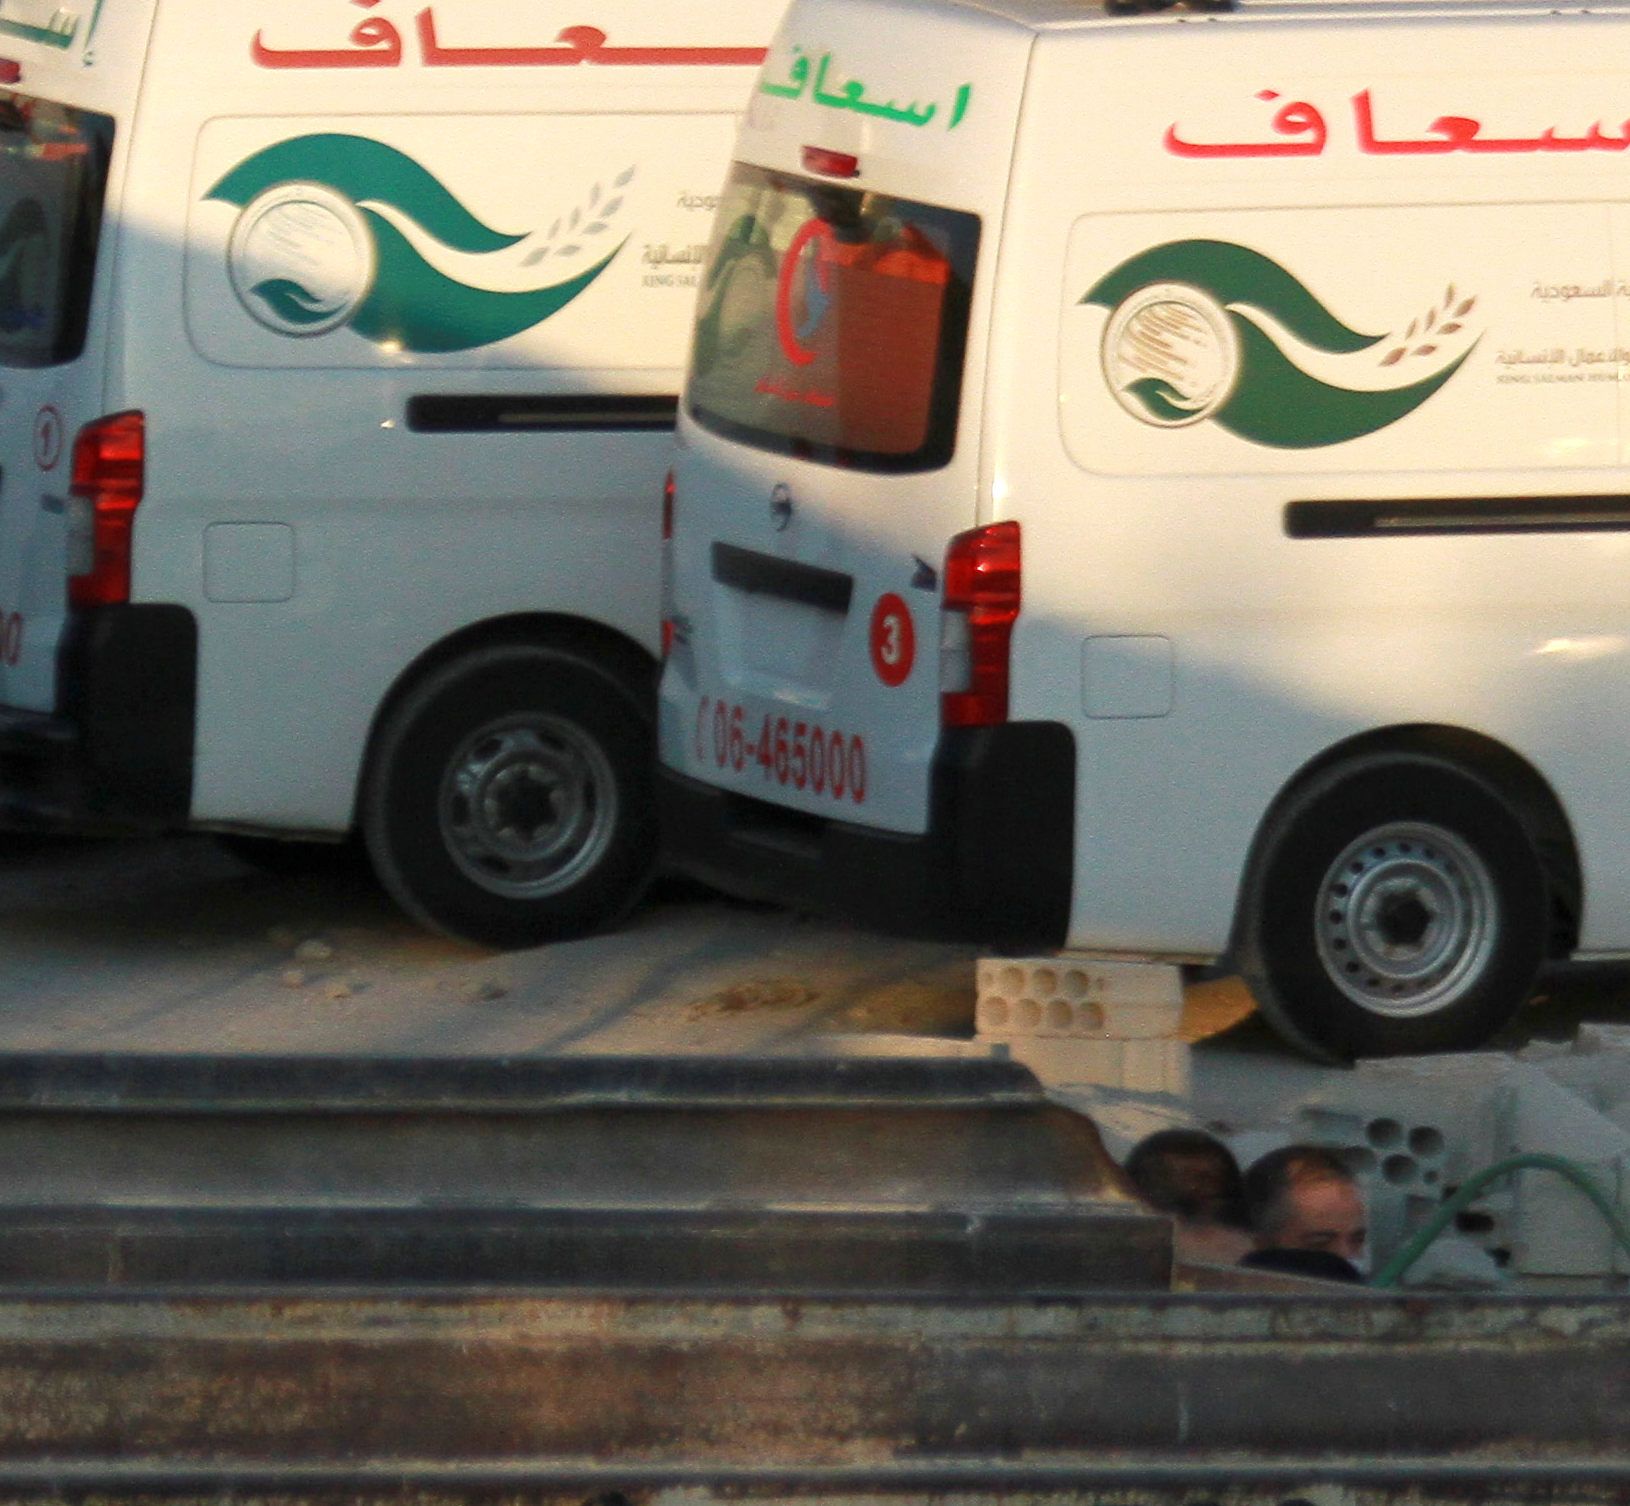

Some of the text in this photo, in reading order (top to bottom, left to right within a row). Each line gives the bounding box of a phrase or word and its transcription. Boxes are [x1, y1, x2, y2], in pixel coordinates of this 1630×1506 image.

[759, 45, 971, 131] اسعاف
[880, 613, 901, 666] 3
[712, 698, 868, 805] 06-465000
